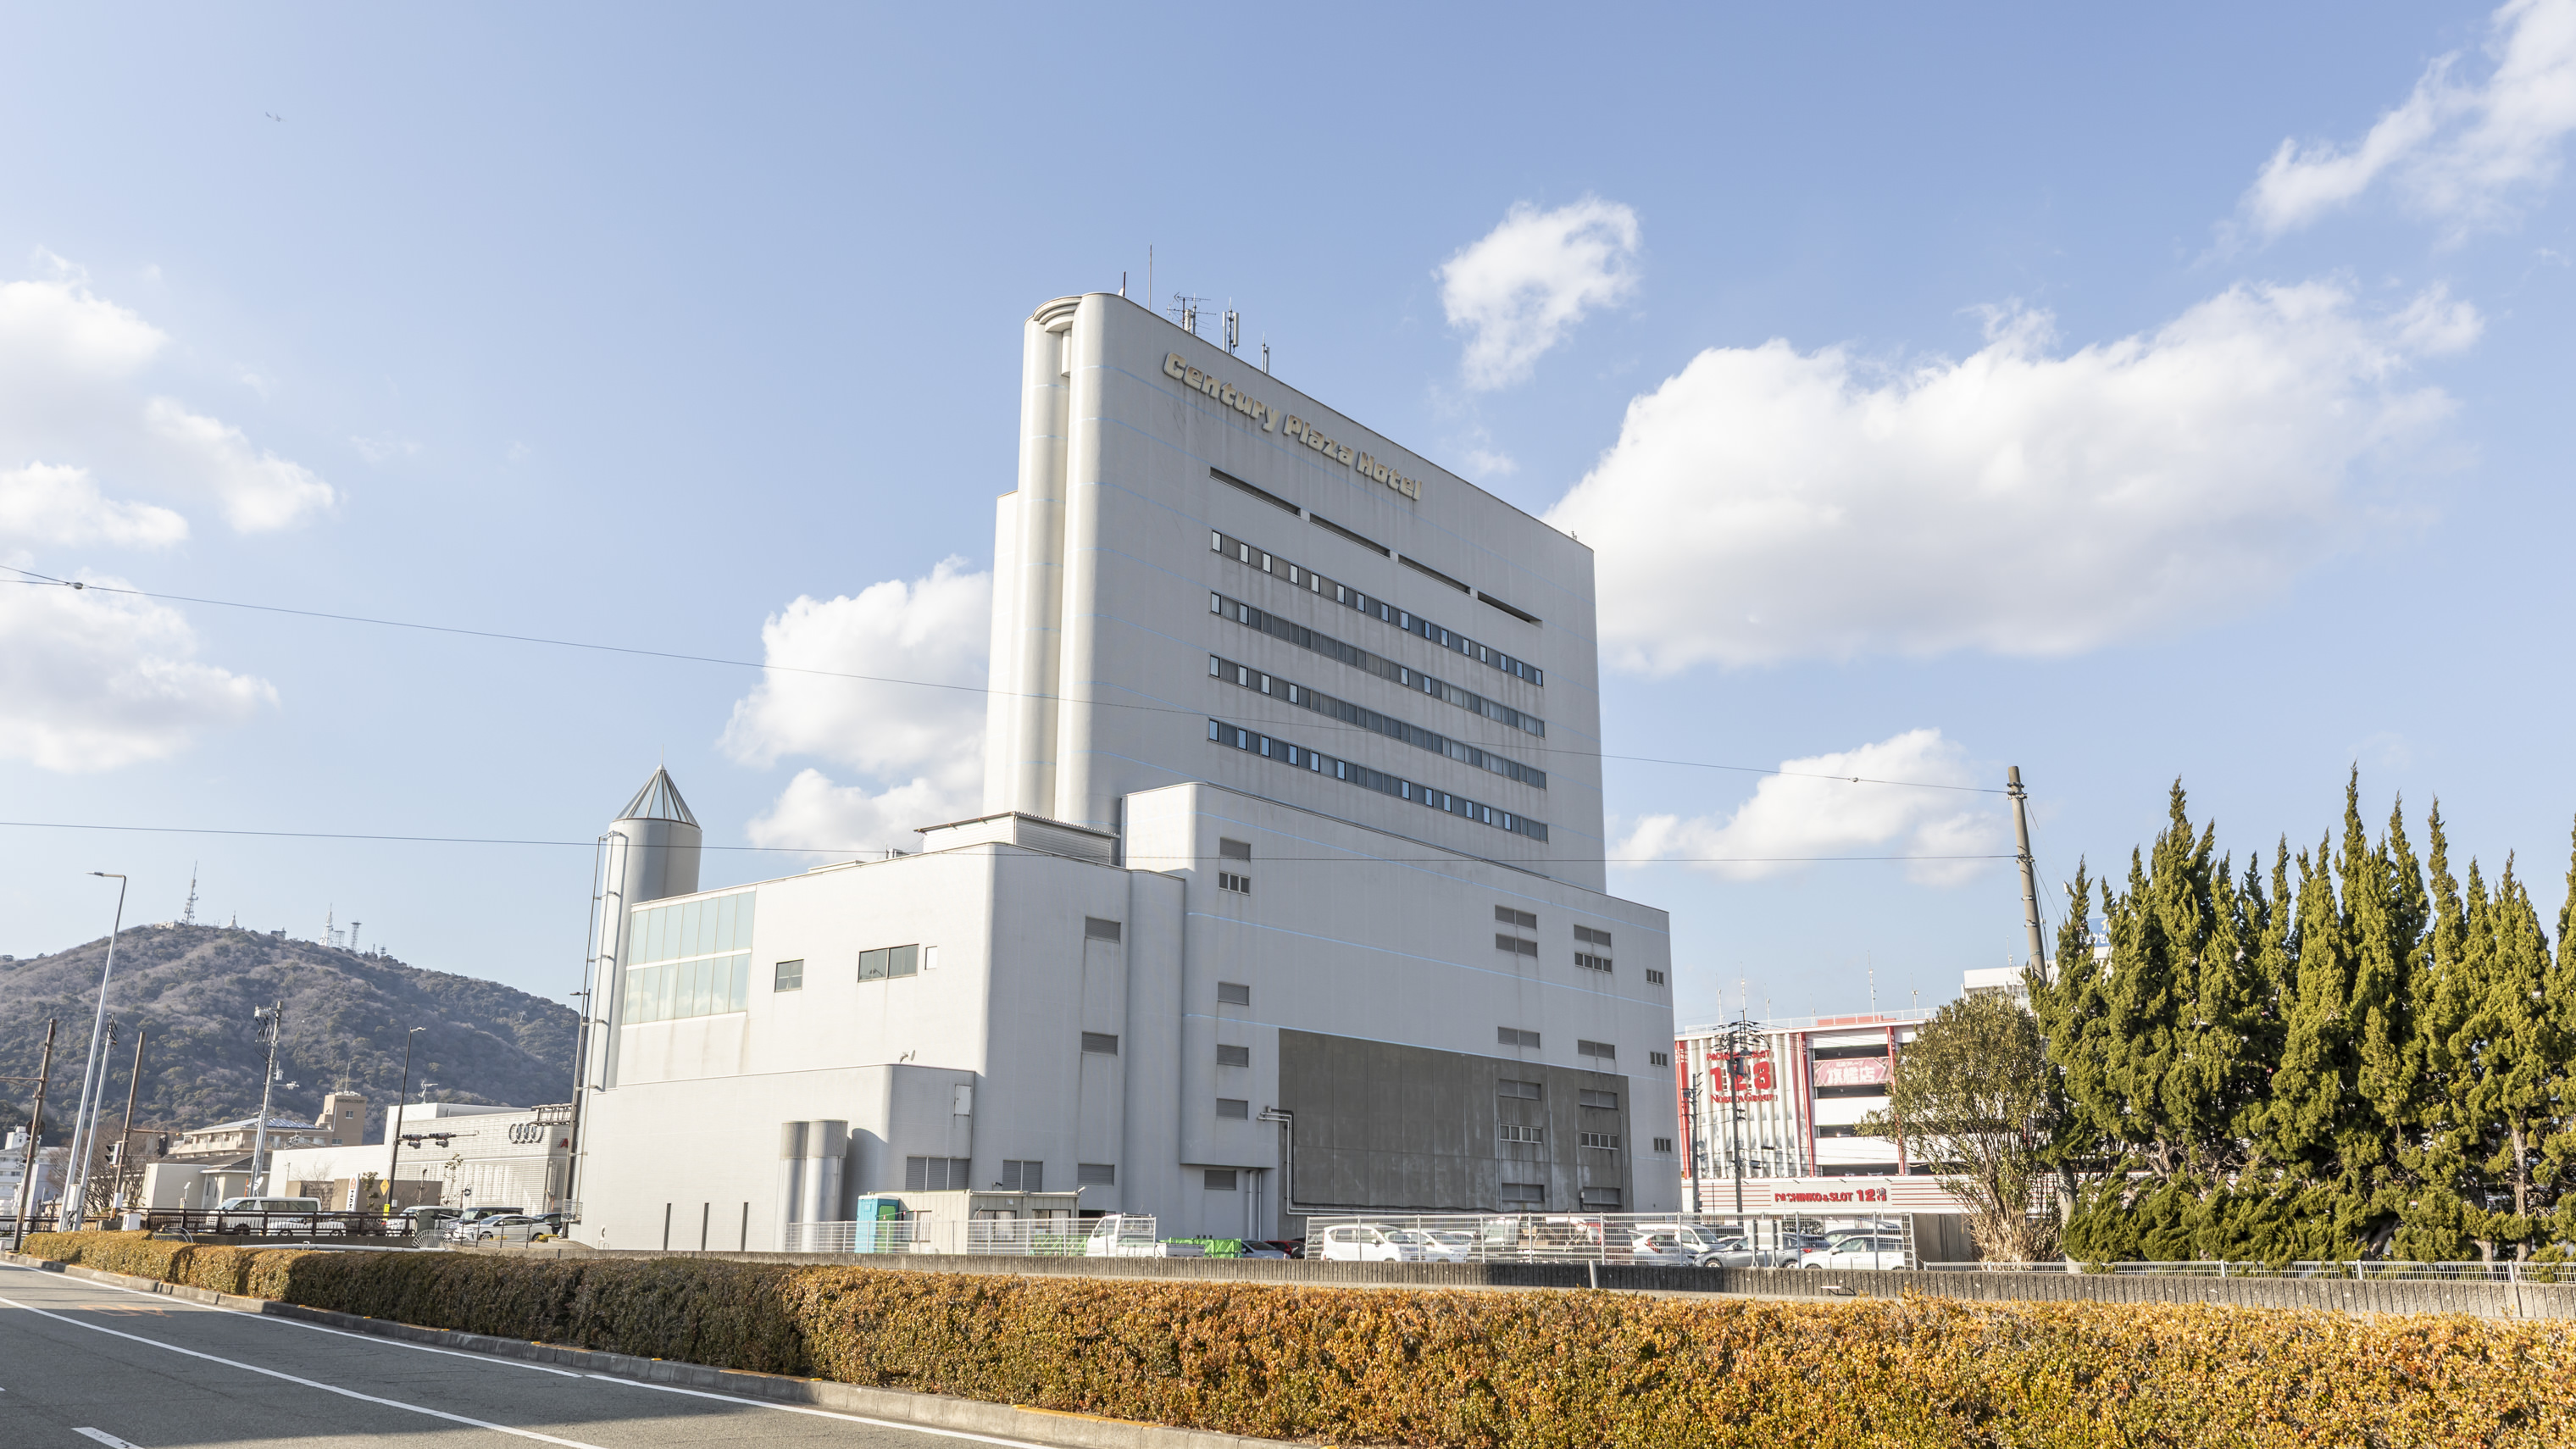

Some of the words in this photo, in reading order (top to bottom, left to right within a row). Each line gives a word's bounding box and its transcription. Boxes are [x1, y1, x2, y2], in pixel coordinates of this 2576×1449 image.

[1163, 353, 1280, 433] Century
[1282, 414, 1354, 467] Plaza
[1356, 451, 1422, 501] Hotel
[1856, 1187, 1887, 1202] 123
